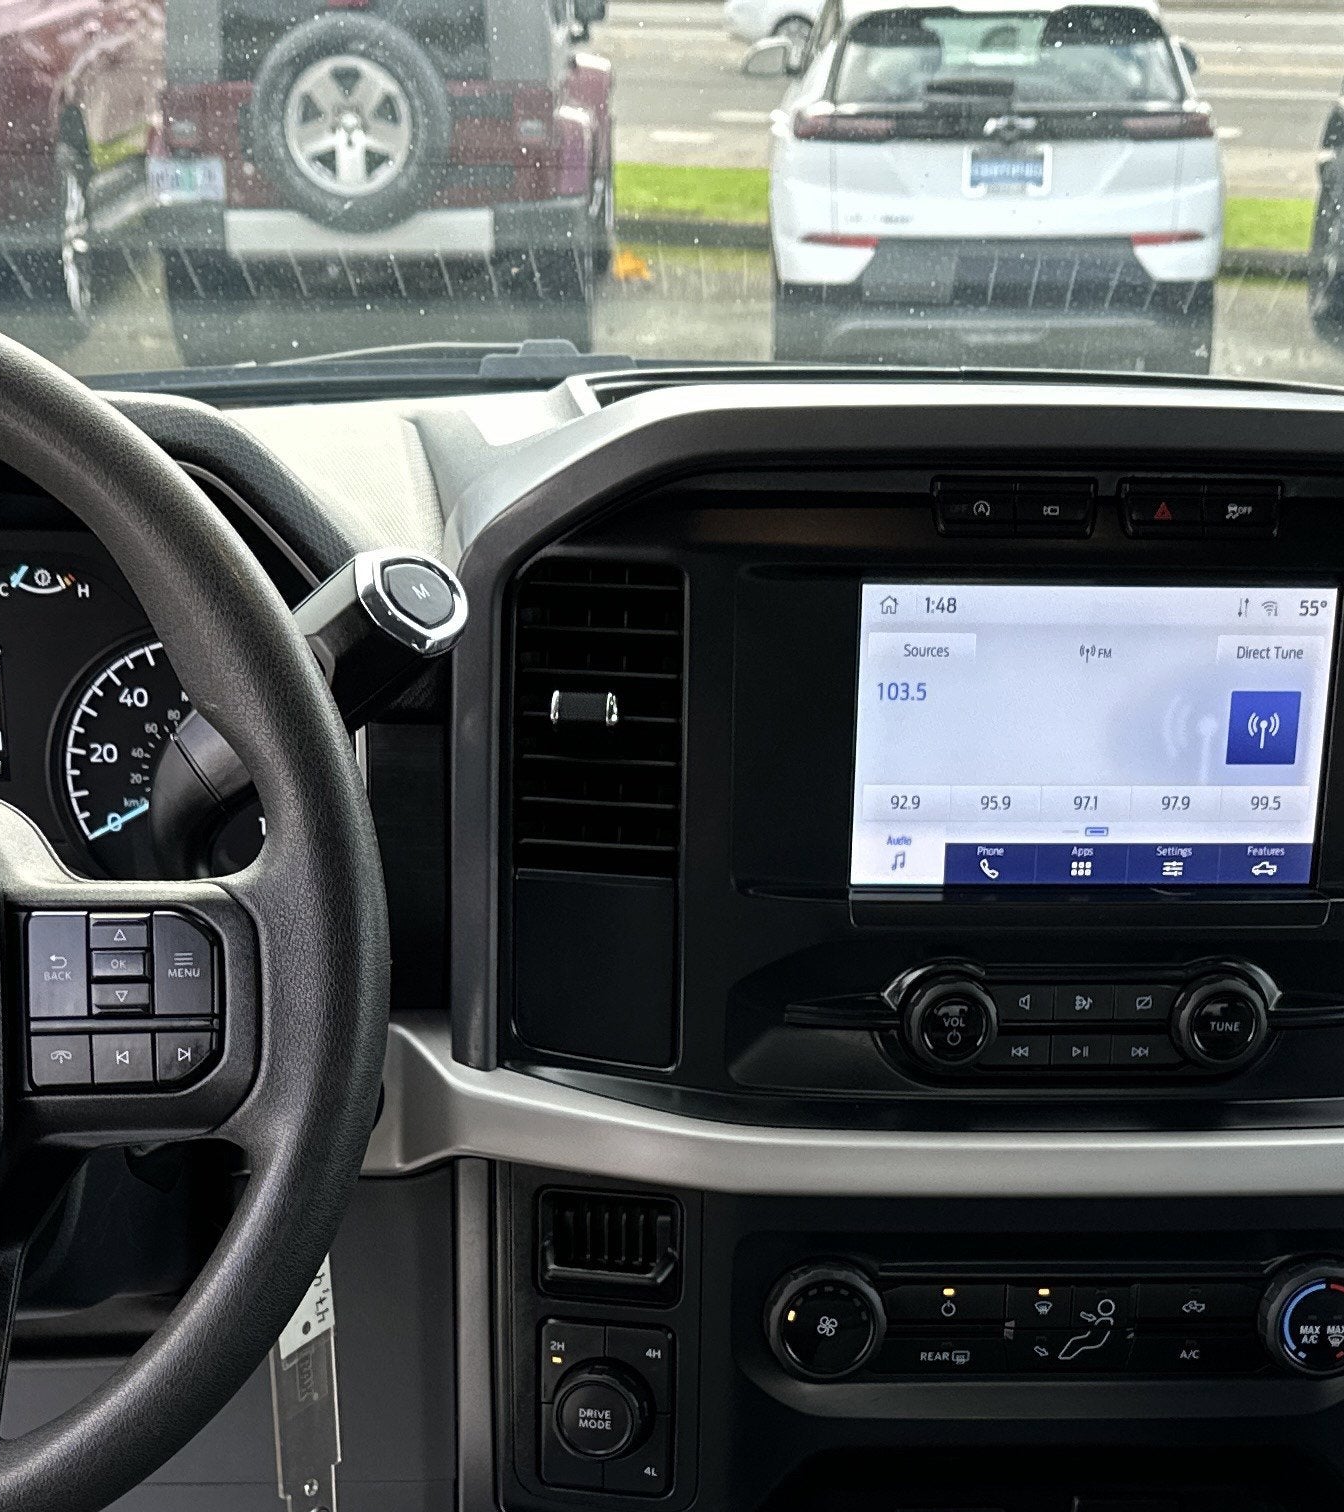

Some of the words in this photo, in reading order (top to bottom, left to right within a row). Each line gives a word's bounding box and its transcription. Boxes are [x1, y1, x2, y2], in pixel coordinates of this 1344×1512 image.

[0, 582, 10, 597] C
[78, 583, 89, 598] H
[411, 583, 431, 600] M
[925, 597, 957, 614] 1:48
[1299, 600, 1328, 617] 55°
[903, 644, 950, 658] Sources
[1098, 649, 1112, 659] FM
[1237, 645, 1271, 660] Direct
[1274, 645, 1304, 660] Tune
[877, 682, 927, 701] 103.5
[119, 688, 148, 708] 40
[167, 709, 181, 721] 80
[144, 723, 158, 734] 60
[89, 743, 118, 763] 20
[130, 747, 144, 759] 40
[129, 772, 143, 785] 20
[891, 795, 921, 810] 92.9
[981, 795, 1011, 811] 95.9
[1073, 796, 1098, 811] 97.1
[1161, 796, 1191, 811] 97.9
[1250, 796, 1281, 811] 99.5
[107, 812, 122, 832] 0
[886, 835, 912, 846] Audio
[977, 846, 1005, 857] Phone
[1071, 846, 1094, 857] Apps
[1156, 846, 1193, 858] Settings
[1247, 846, 1285, 857] Features
[110, 959, 127, 970] OK
[44, 971, 72, 981] BACK
[167, 968, 201, 979] MENU
[943, 1016, 966, 1028] VOL
[1209, 1020, 1241, 1033] TUNE
[1299, 1324, 1321, 1335] MAX
[1301, 1334, 1318, 1344] A/C
[550, 1340, 565, 1351] 2H
[645, 1348, 662, 1359] 4H
[920, 1351, 950, 1362] REAR
[1179, 1349, 1200, 1360] A/C
[578, 1407, 612, 1420] DRIVE
[578, 1418, 612, 1430] MODE
[643, 1466, 658, 1477] 4L
